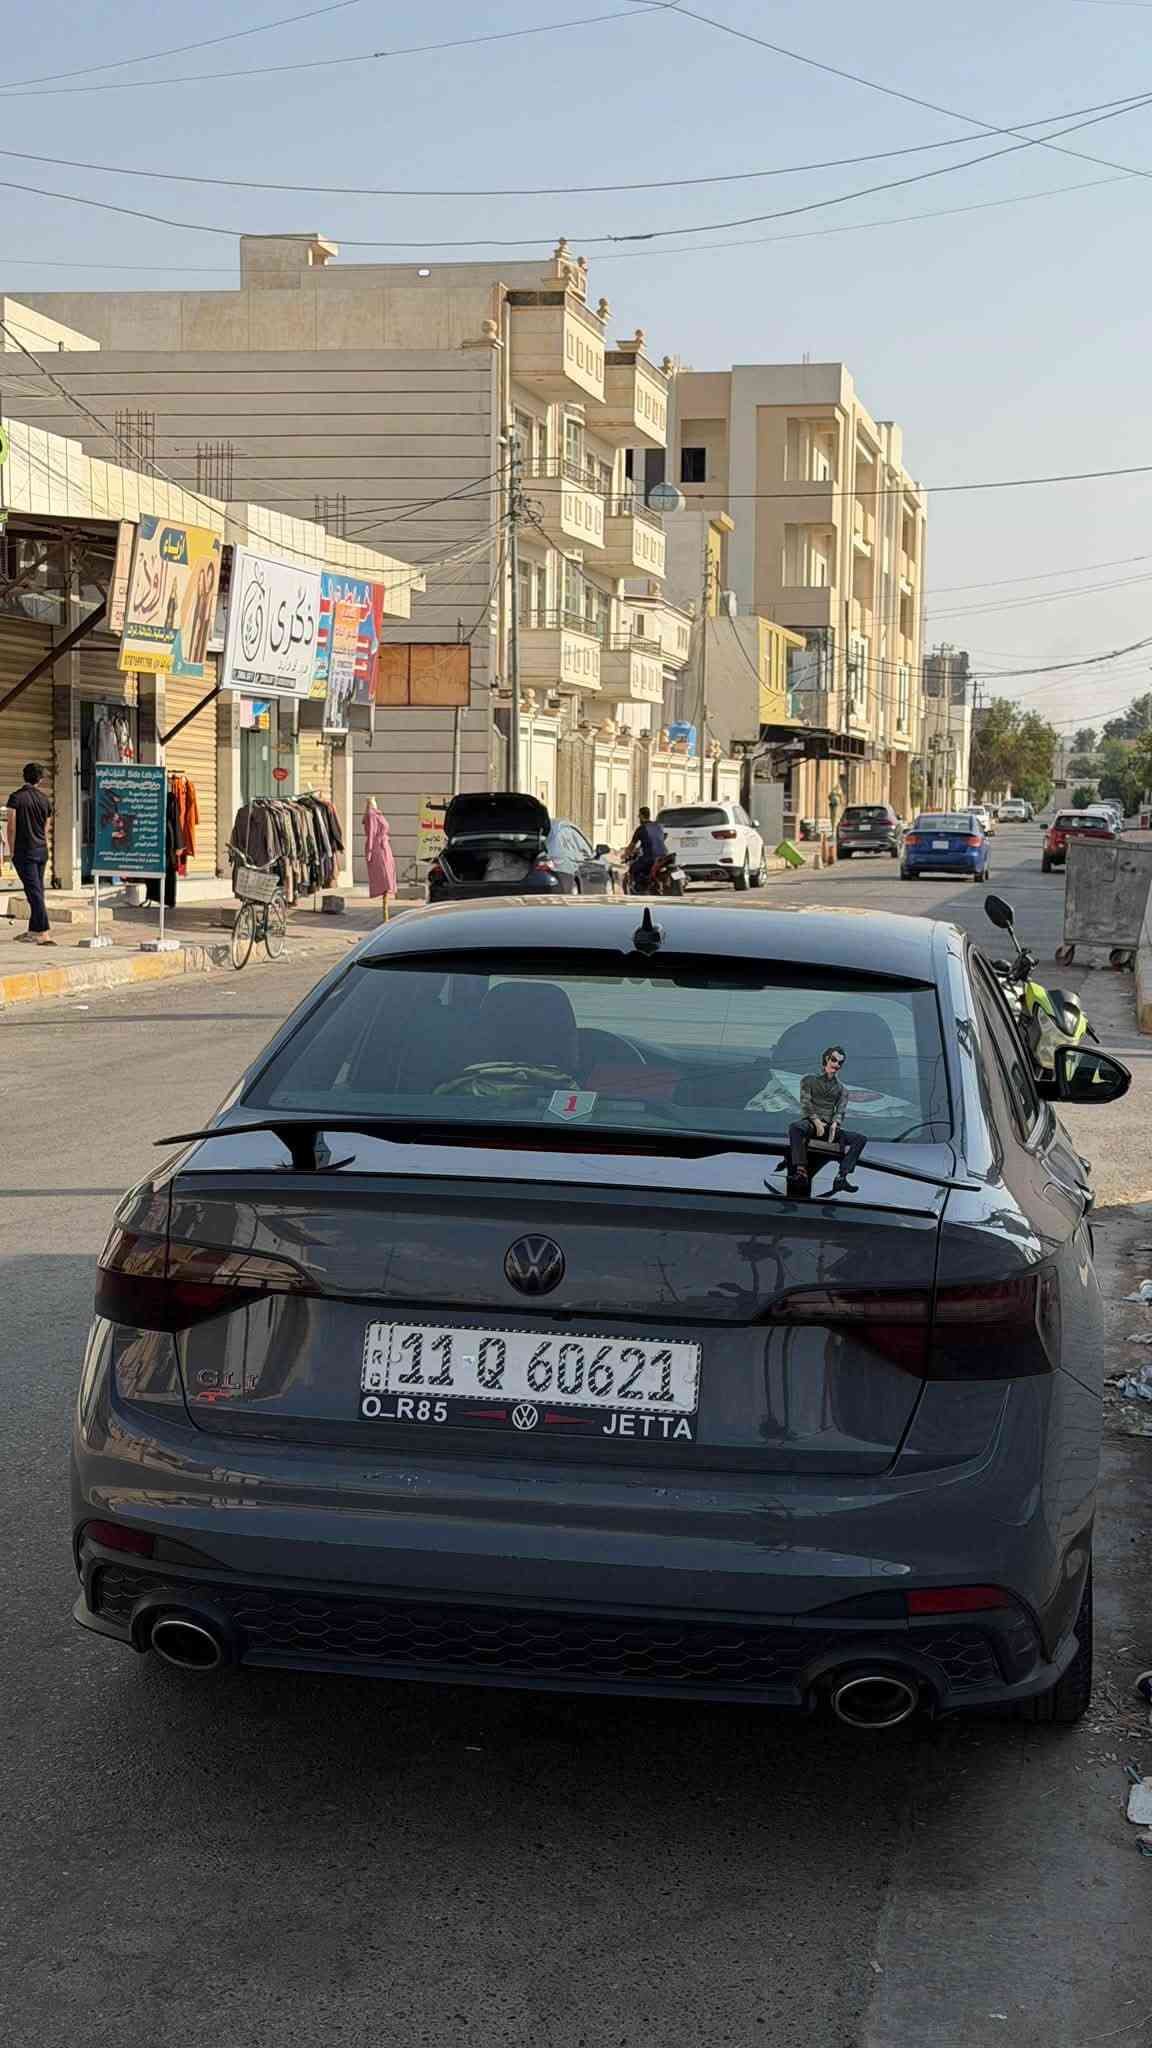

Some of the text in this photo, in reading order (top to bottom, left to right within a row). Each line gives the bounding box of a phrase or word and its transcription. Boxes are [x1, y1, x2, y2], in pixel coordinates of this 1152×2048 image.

[398, 1332, 676, 1402] 11 Q 60621
[361, 1396, 448, 1423] O_R85
[603, 1413, 693, 1440] JETTA
